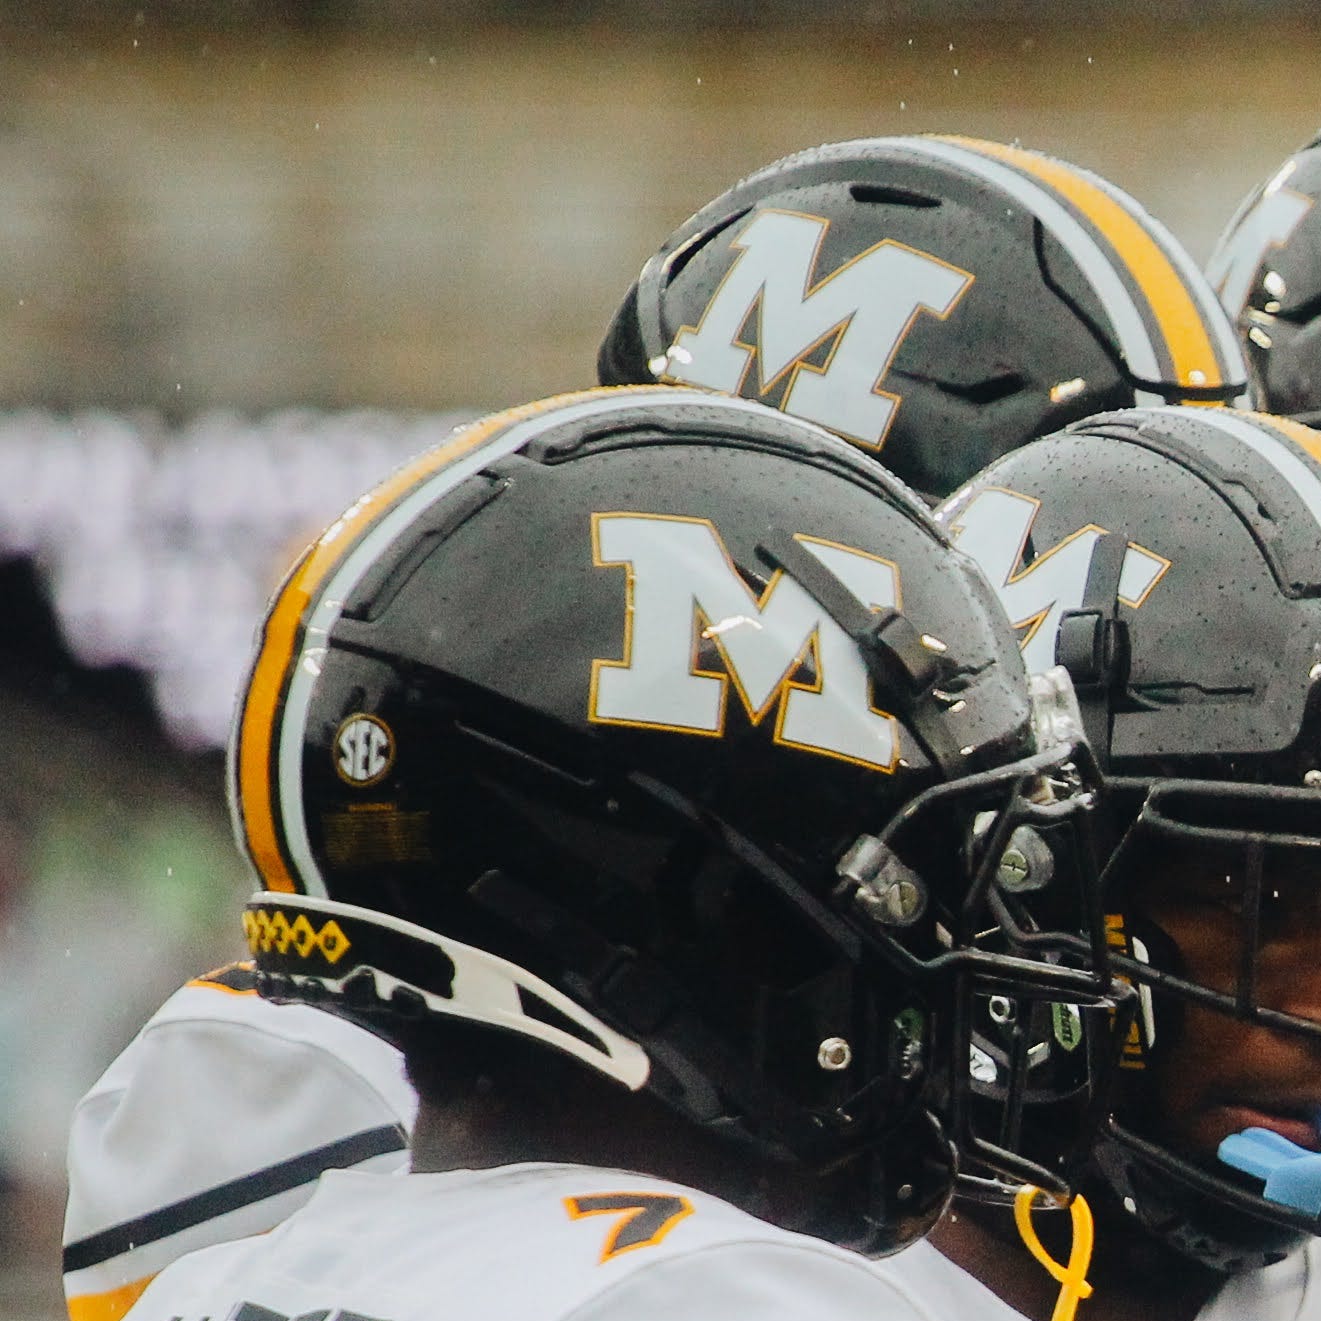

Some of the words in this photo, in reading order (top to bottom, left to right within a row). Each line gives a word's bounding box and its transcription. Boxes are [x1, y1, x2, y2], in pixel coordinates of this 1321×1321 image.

[662, 207, 976, 452] M
[338, 719, 390, 782] SEC
[588, 512, 902, 775] M
